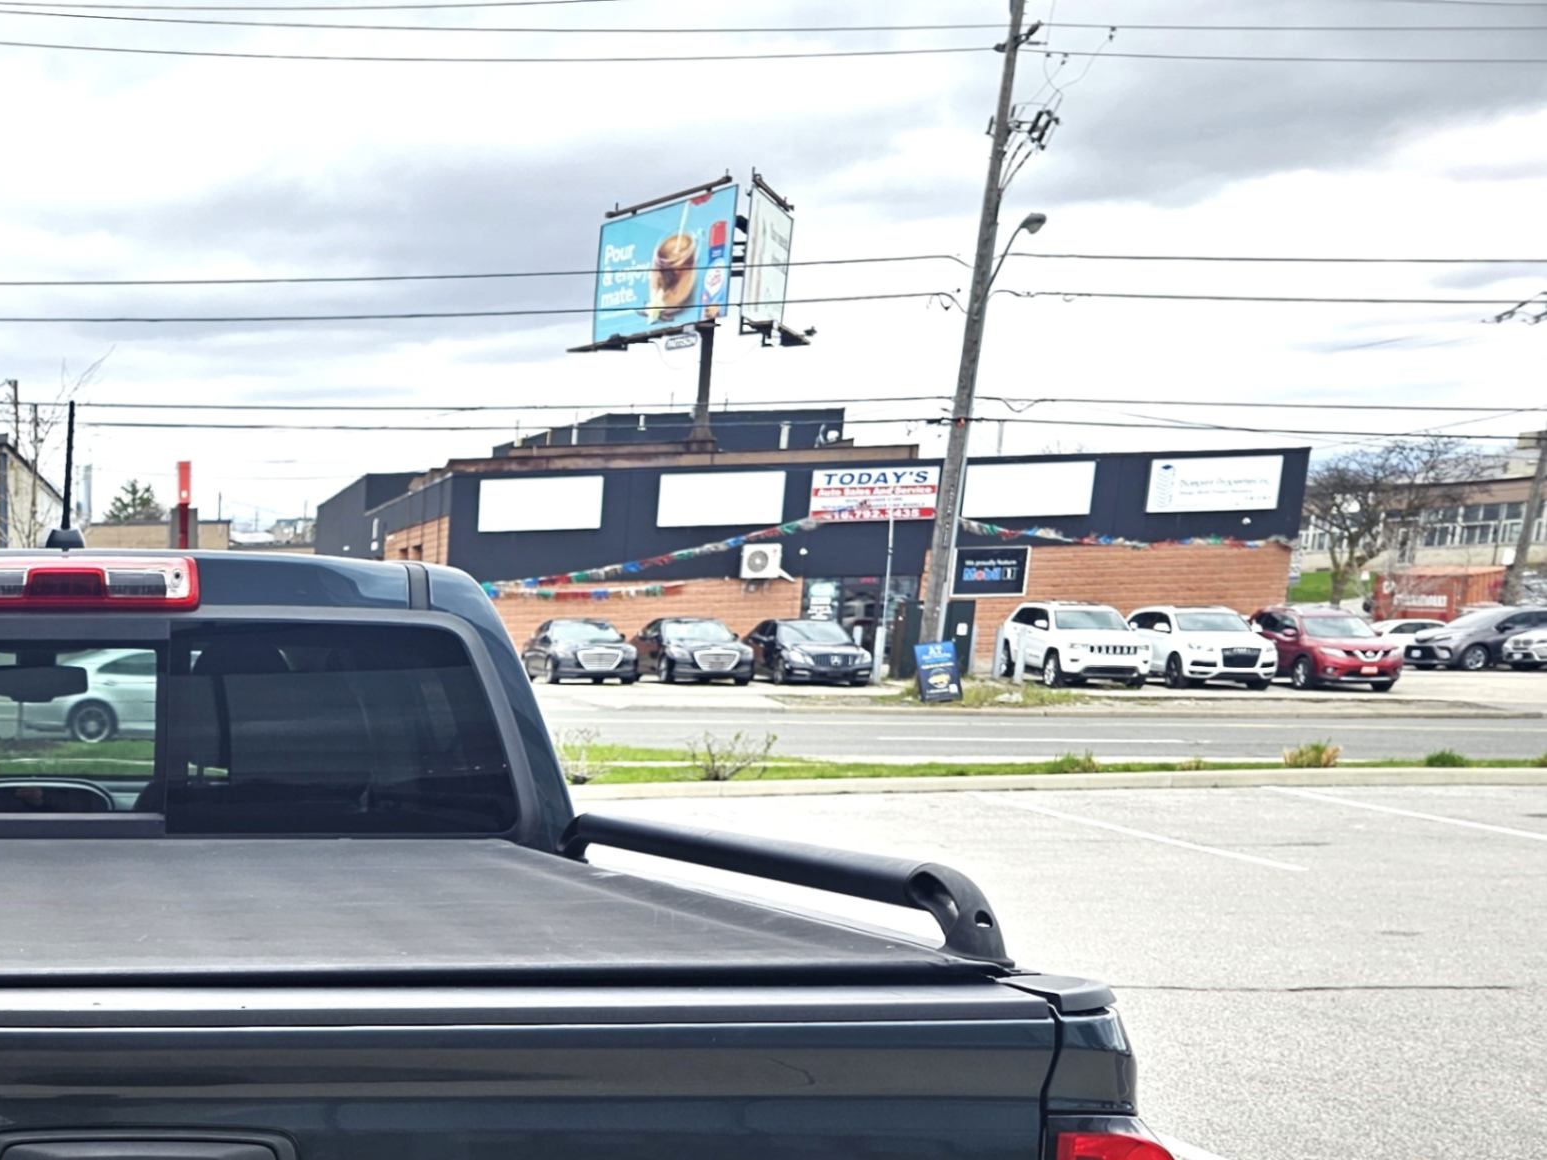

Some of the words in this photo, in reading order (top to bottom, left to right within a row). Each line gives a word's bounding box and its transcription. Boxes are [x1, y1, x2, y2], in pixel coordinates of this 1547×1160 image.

[604, 243, 636, 265] Pour
[602, 266, 613, 286] &
[823, 471, 929, 485] TODAY'S
[894, 484, 933, 495] Service
[962, 566, 1001, 581] Mobil
